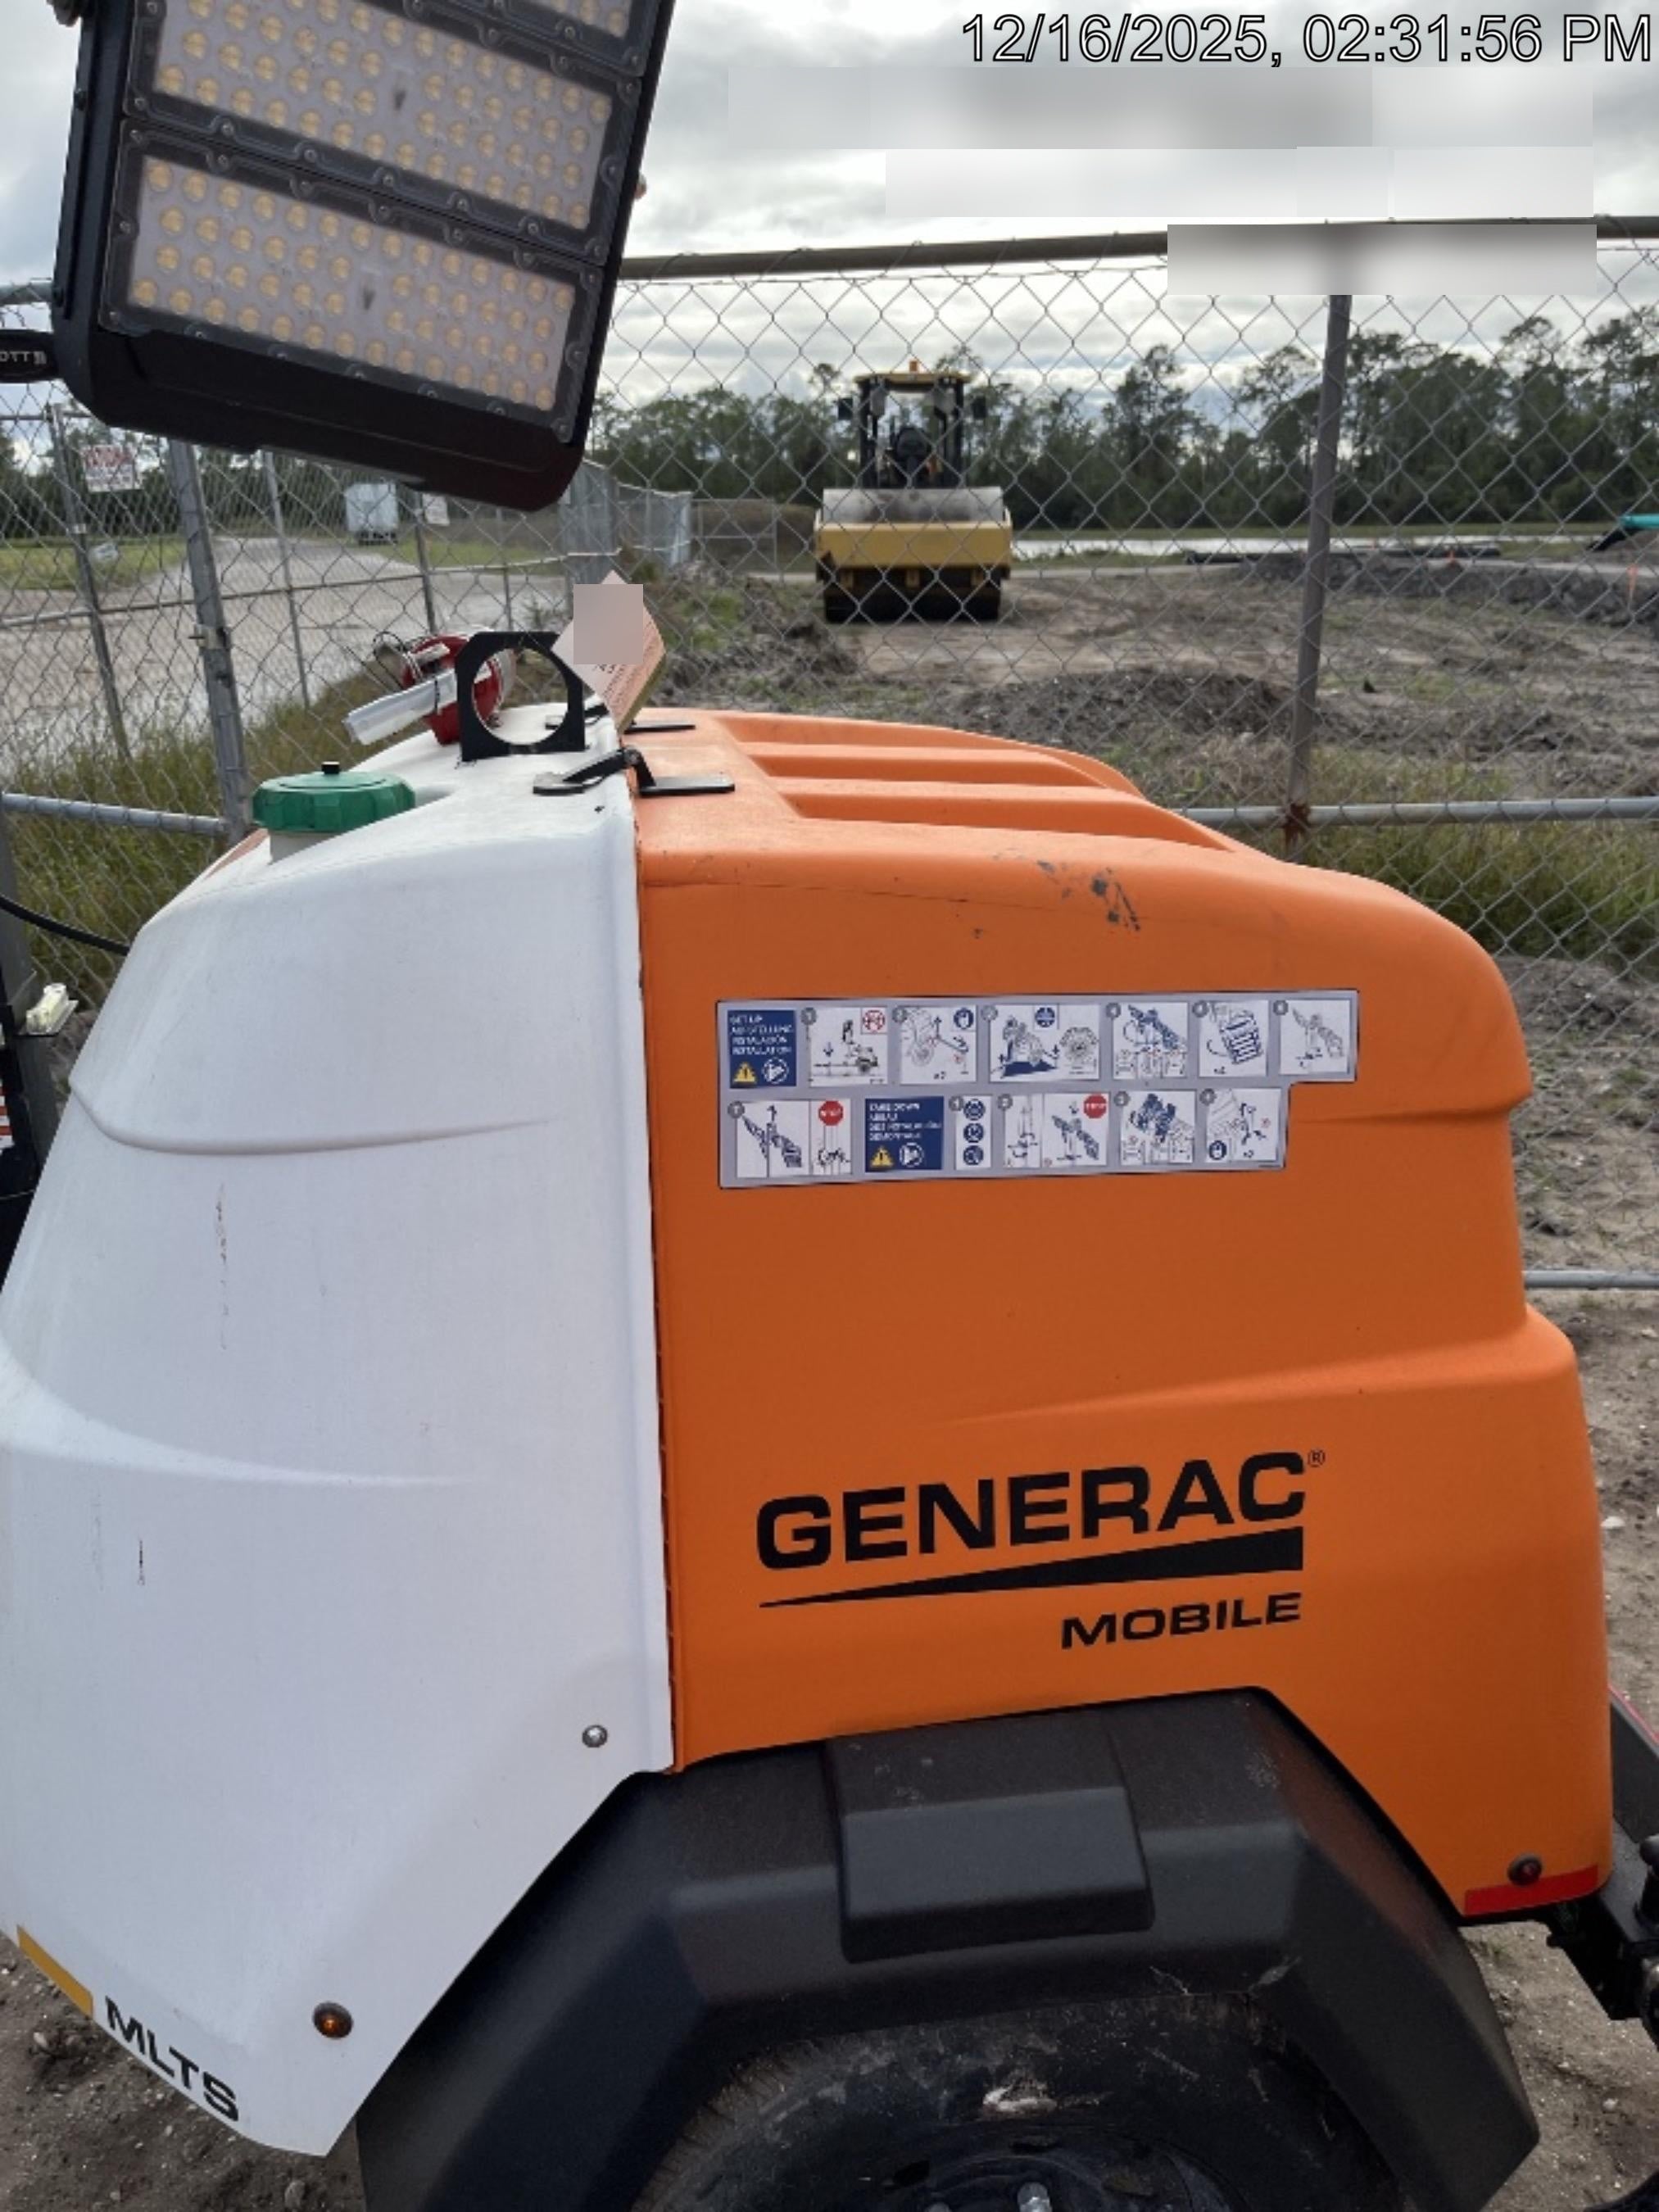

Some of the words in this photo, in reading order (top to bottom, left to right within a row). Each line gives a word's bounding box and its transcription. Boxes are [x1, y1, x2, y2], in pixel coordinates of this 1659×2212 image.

[756, 1452, 1306, 1570] GENERAC
[1061, 1592, 1302, 1650] MOBILE
[105, 1996, 239, 2122] MLTS
